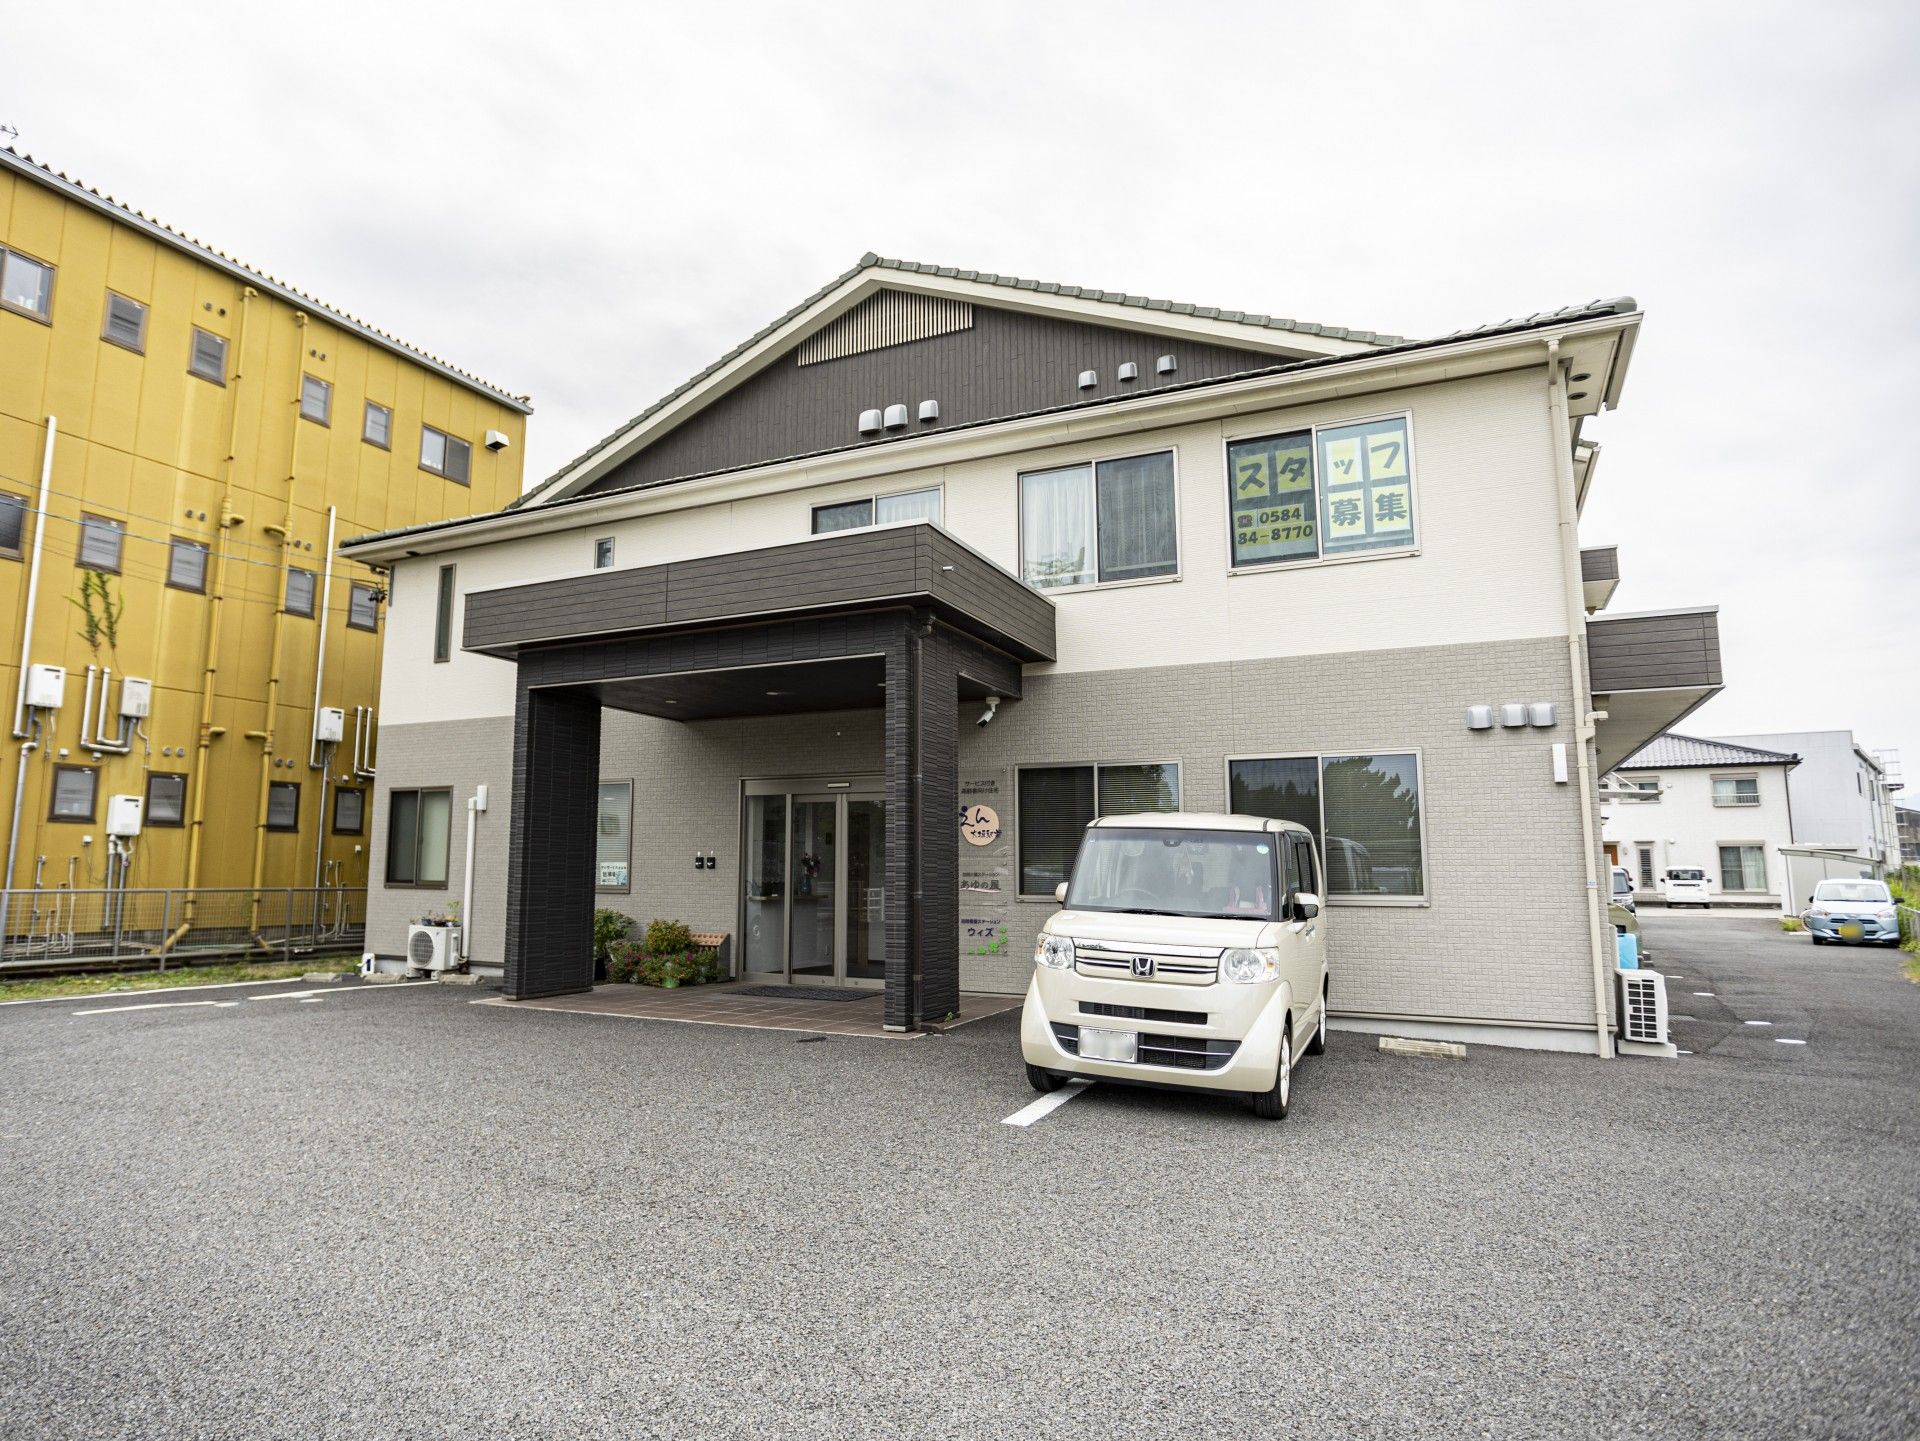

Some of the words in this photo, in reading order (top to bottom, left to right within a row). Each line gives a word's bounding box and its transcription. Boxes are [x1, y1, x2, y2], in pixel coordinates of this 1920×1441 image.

[1258, 507, 1302, 529] 0584
[1330, 493, 1408, 527] 募集
[1238, 524, 1314, 545] 84-8770
[967, 927, 994, 937] ウィズ
